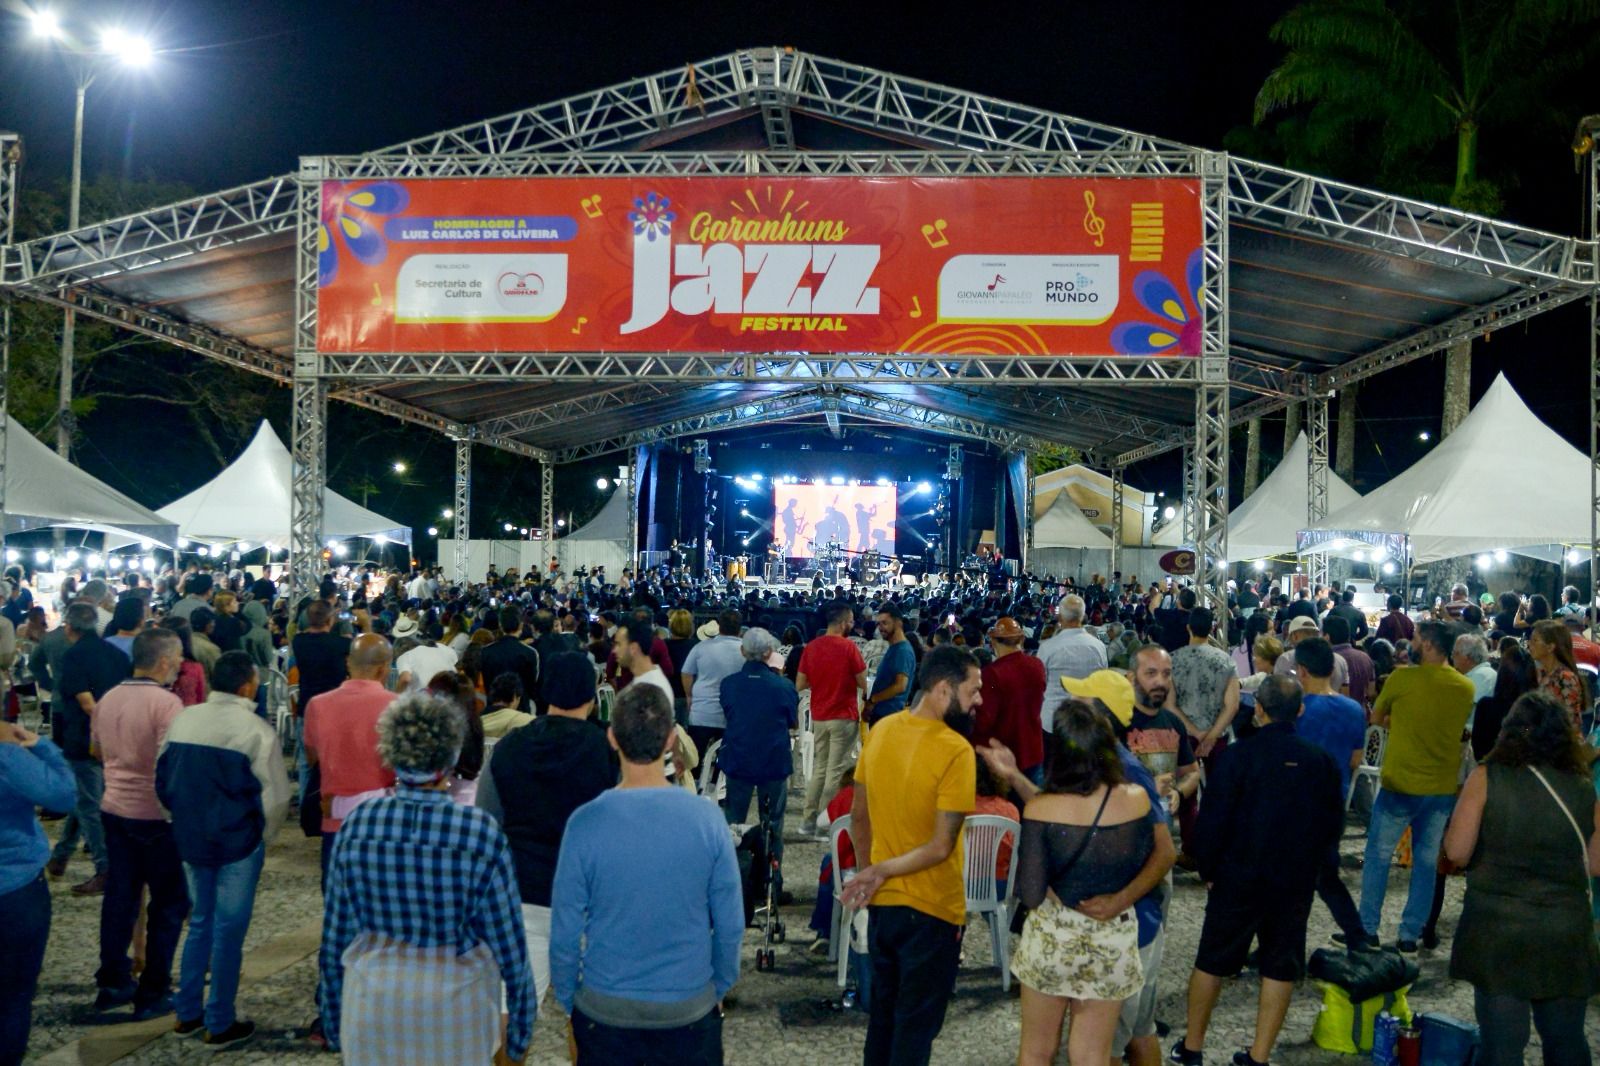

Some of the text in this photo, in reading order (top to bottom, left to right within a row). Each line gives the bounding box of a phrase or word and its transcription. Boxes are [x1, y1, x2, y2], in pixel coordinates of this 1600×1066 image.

[433, 219, 527, 229] HOMENAGEM A
[689, 211, 849, 242] Garanhuns
[402, 229, 559, 240] LUIZ CARLOS DE OLIVEIRA
[620, 219, 881, 335] jazz
[415, 279, 482, 288] Secretaria de
[1046, 281, 1075, 291] PRO
[445, 289, 482, 298] Cultura
[1046, 292, 1099, 303] MUNDO
[740, 316, 848, 332] FESTIVAL
